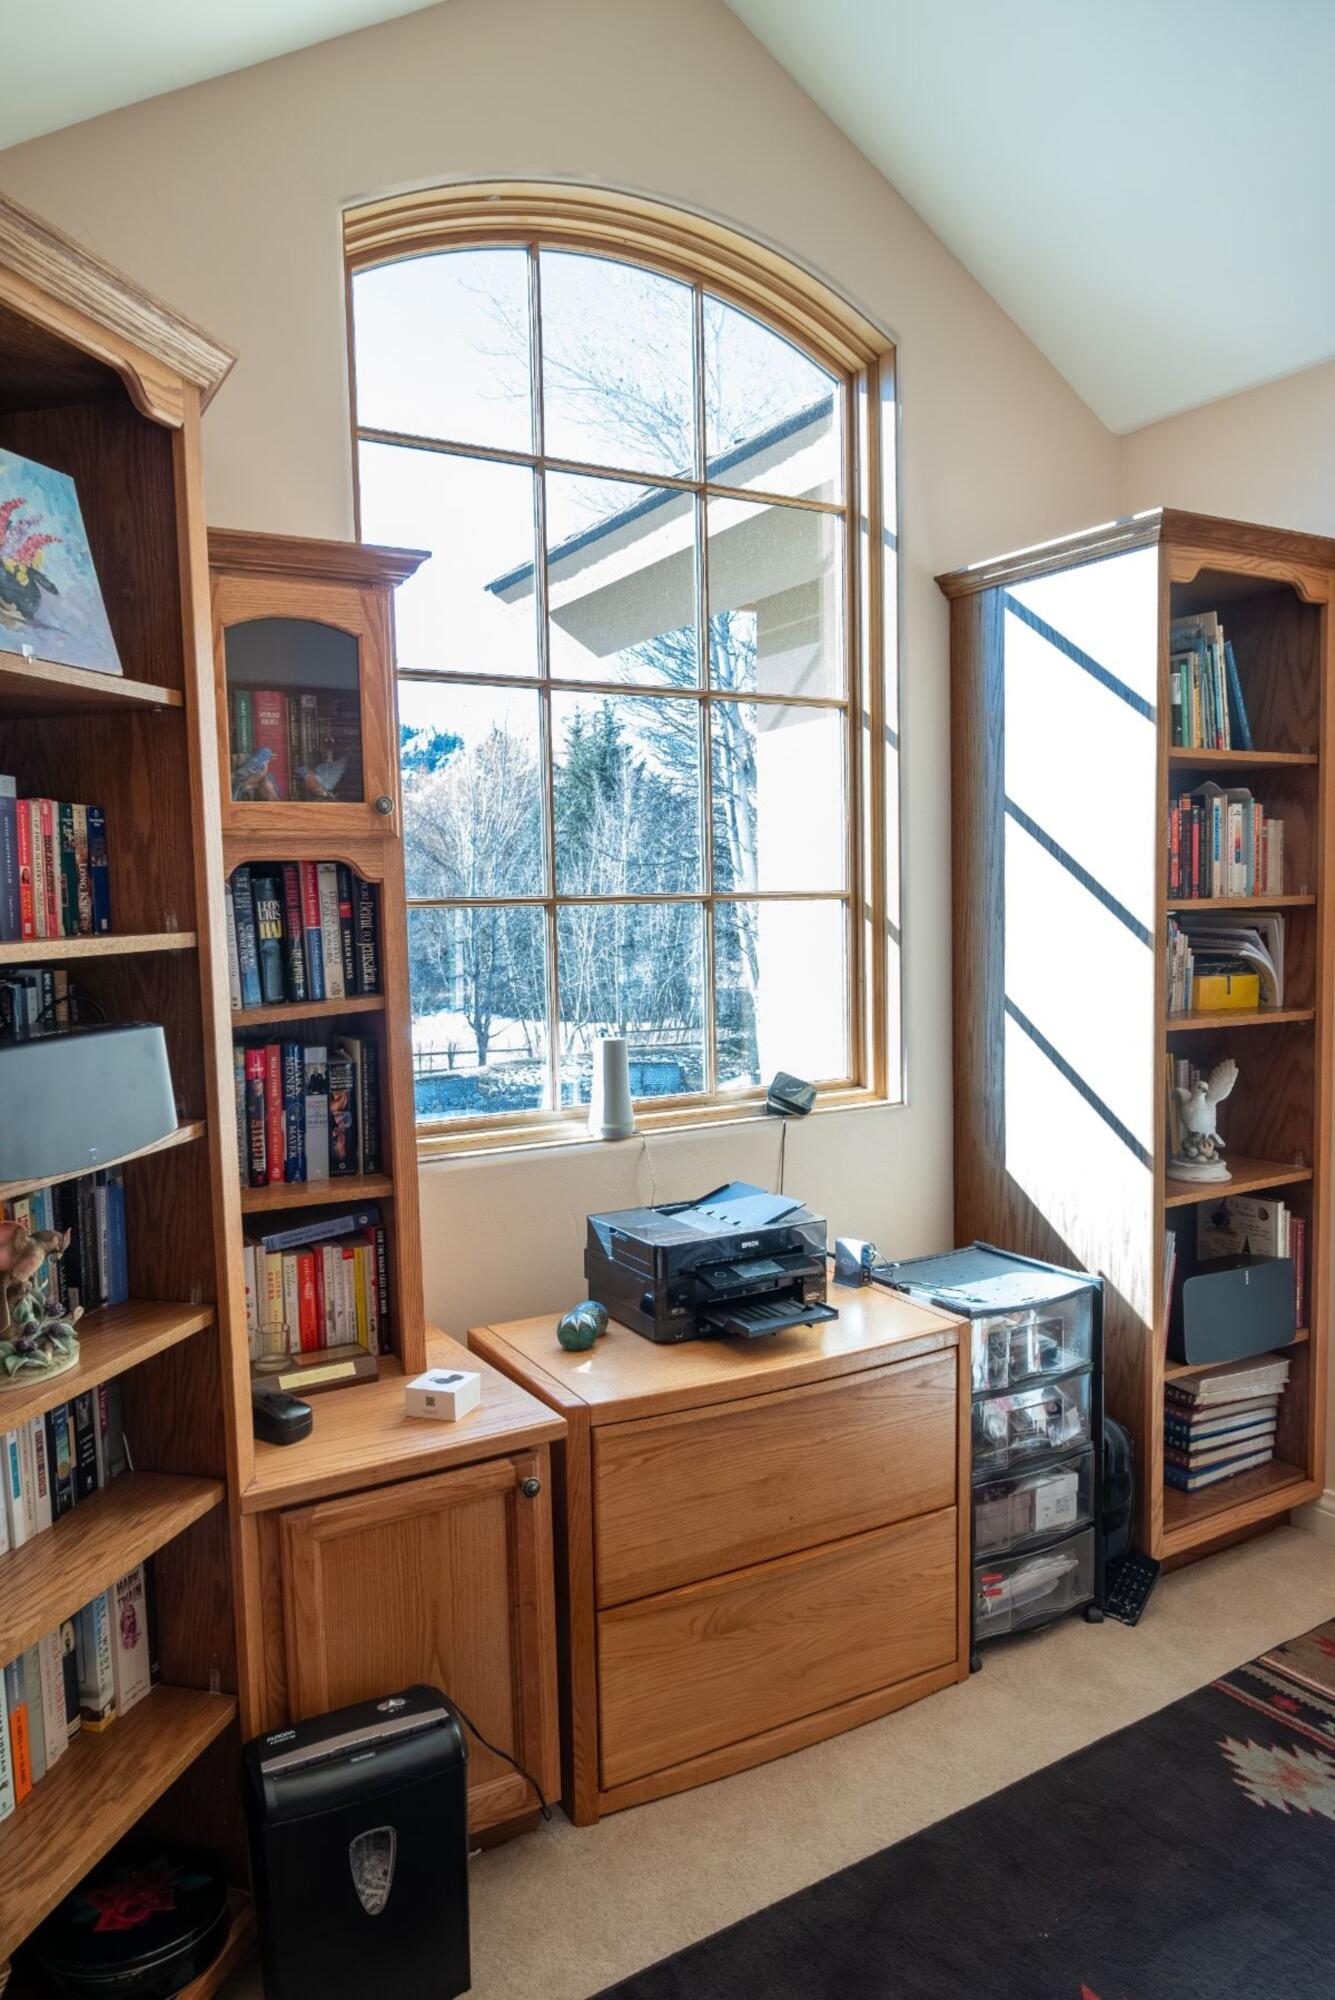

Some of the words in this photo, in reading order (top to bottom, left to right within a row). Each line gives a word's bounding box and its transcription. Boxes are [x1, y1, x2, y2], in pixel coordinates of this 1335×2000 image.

[78, 863, 87, 889] LONG
[306, 864, 315, 896] Michael
[80, 891, 89, 919] KNIFE
[257, 900, 280, 910] LEON
[258, 910, 281, 920] URIS
[309, 900, 317, 924] Lewis
[360, 902, 374, 928] Beirut
[346, 958, 354, 979] LIVES
[286, 1056, 296, 1099] MONEY
[288, 1125, 298, 1158] MAYER
[117, 1571, 140, 1592] MARK
[102, 1636, 110, 1671] WEST
[266, 1730, 296, 1743] AURORA
